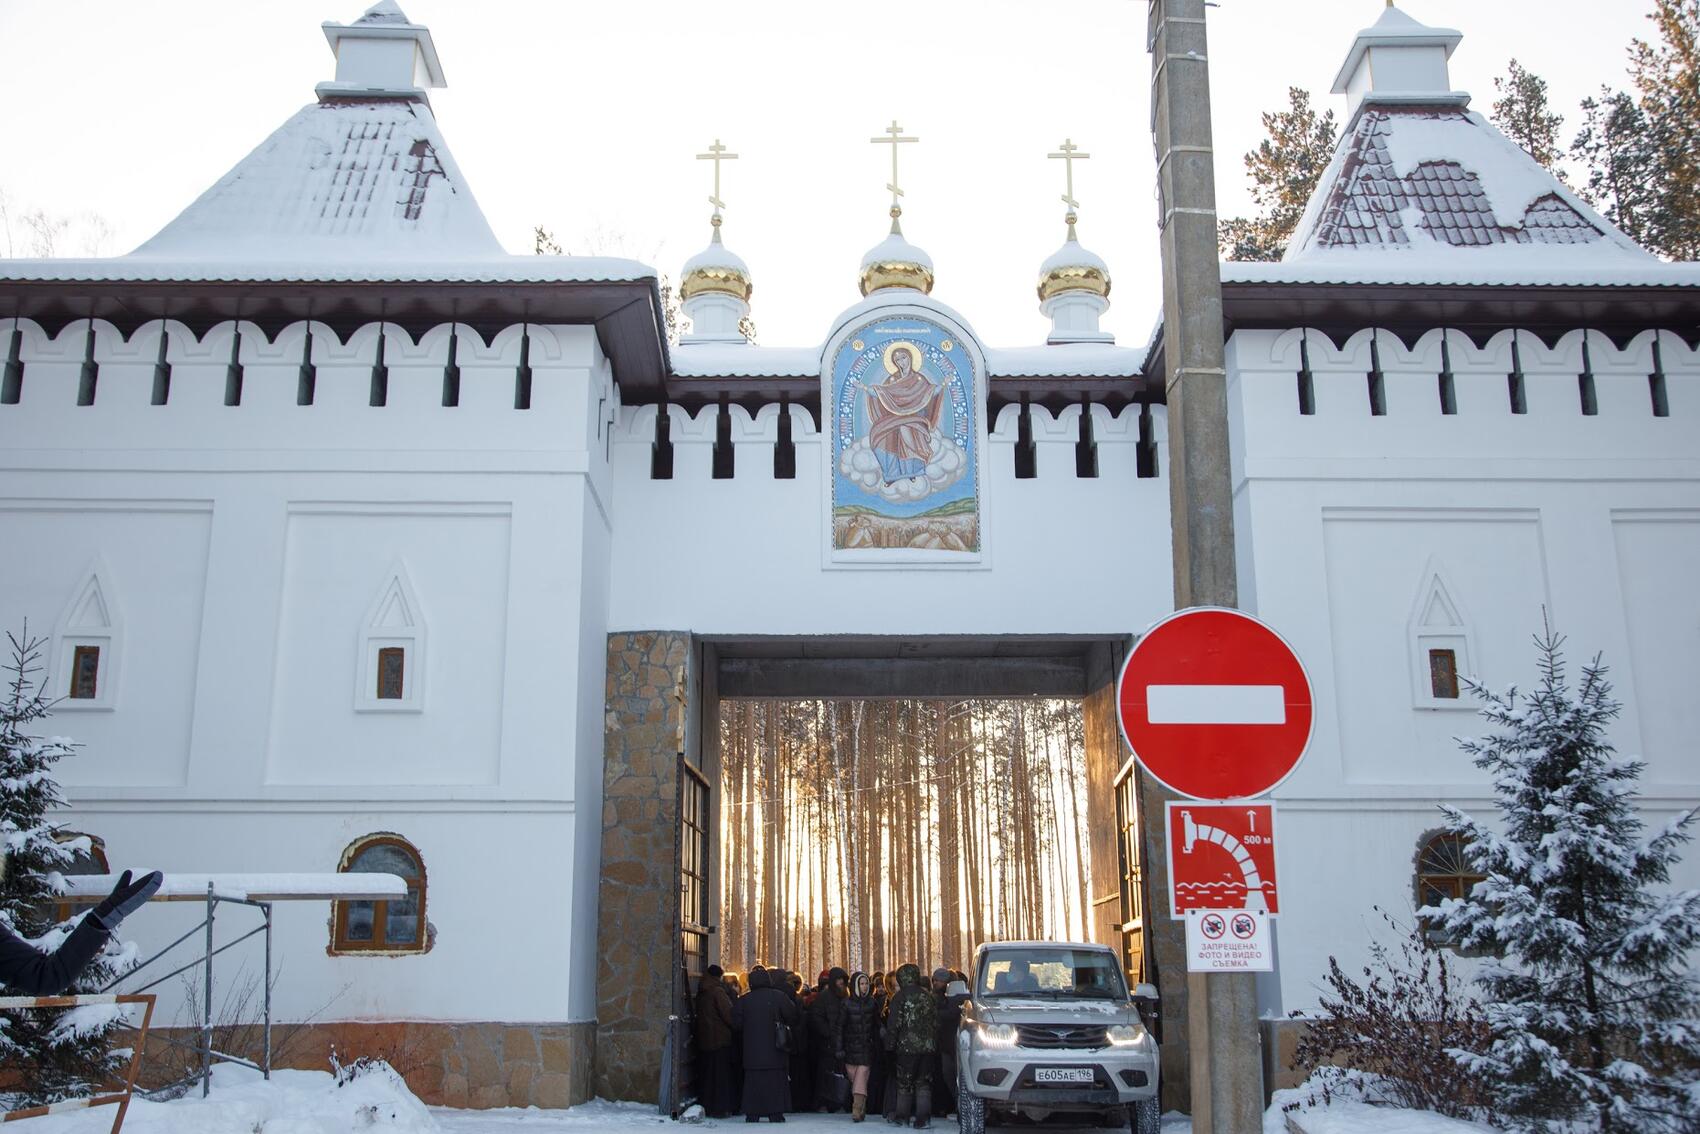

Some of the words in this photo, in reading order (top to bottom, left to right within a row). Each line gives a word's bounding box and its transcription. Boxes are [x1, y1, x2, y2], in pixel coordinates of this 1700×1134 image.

[1243, 835, 1261, 845] 500
[1201, 943, 1258, 951] ЗАПРЕЩЕНА!
[1198, 951, 1222, 959] ФОТО
[1232, 951, 1262, 959] ВИДЕО
[1038, 1070, 1075, 1080] Е605АЕ
[1077, 1069, 1092, 1078] 196
